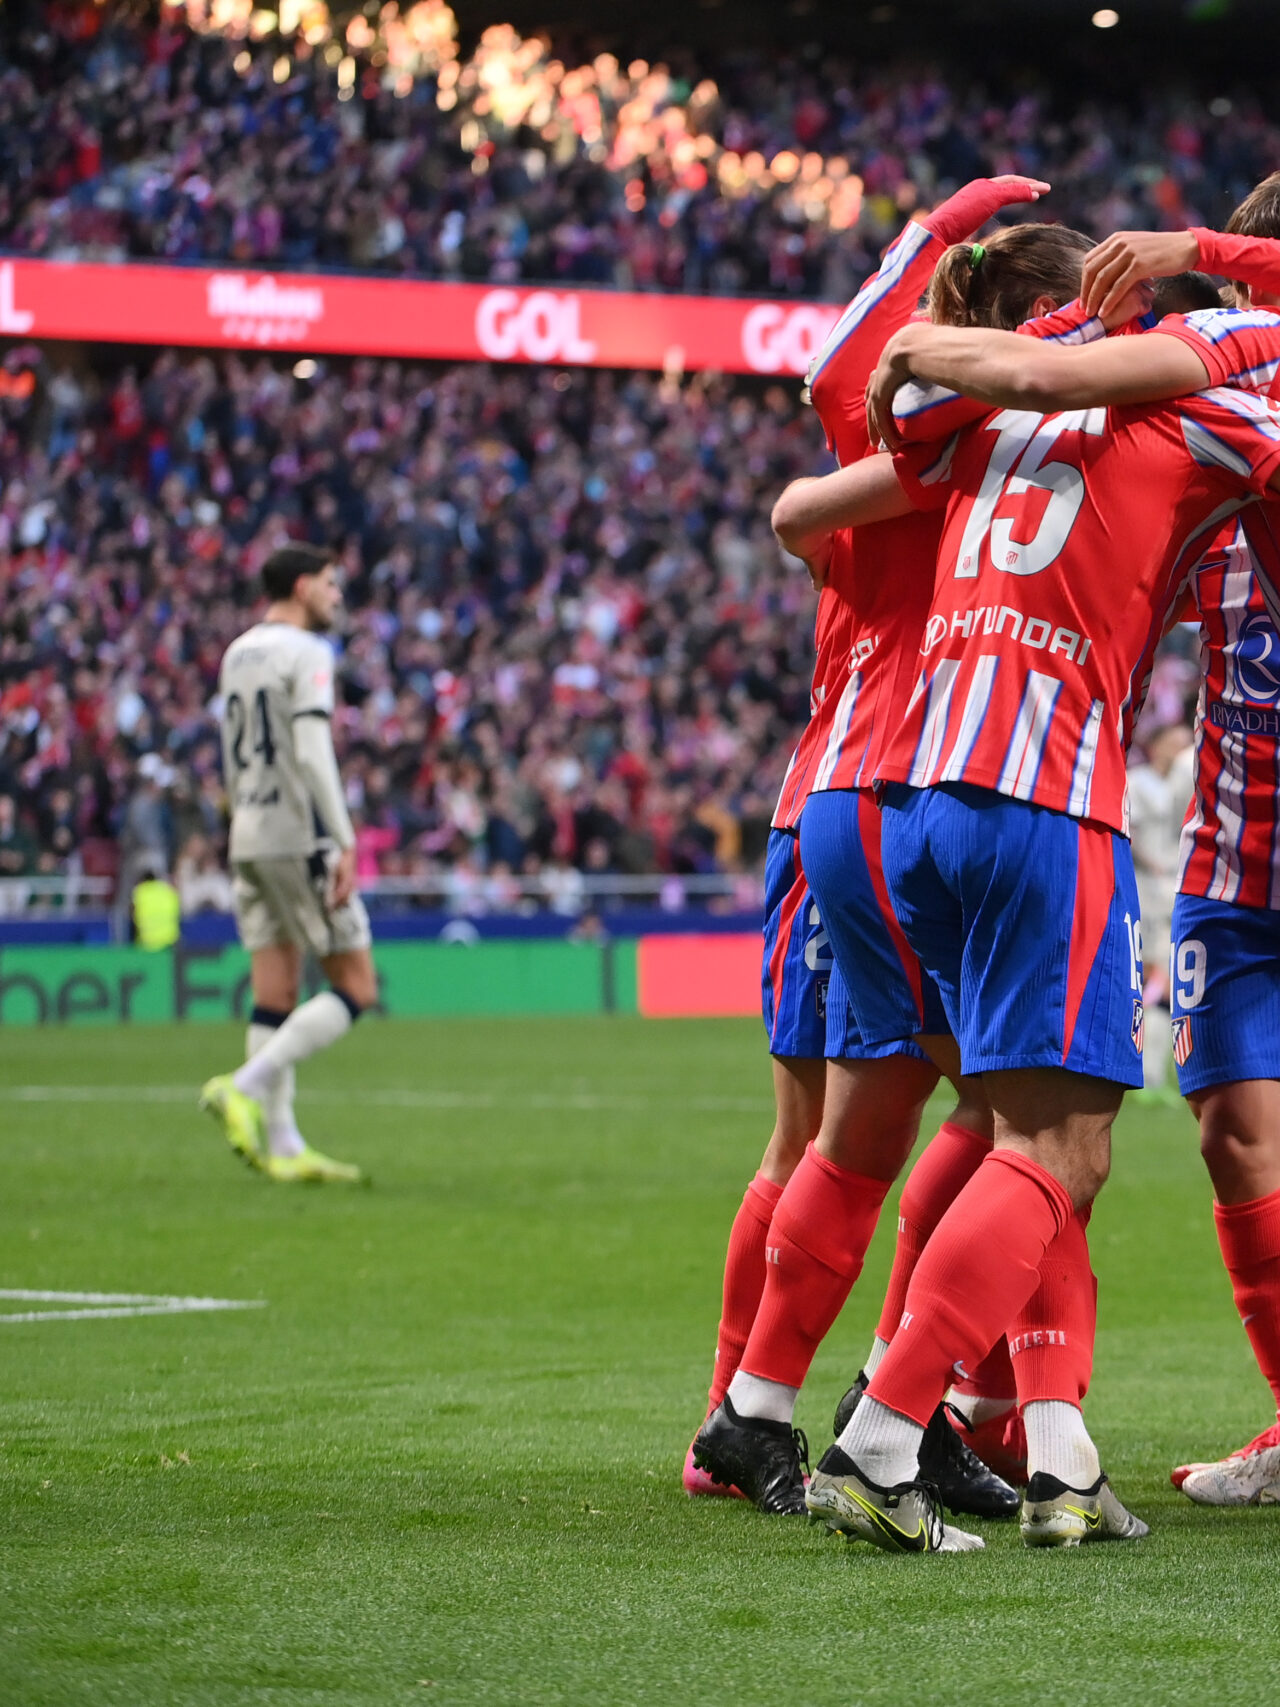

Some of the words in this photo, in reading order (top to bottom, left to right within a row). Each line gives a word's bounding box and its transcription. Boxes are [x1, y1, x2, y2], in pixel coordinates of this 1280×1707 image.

[475, 288, 598, 363] GOL
[741, 304, 842, 374] GO
[953, 407, 1107, 579] 15
[950, 605, 1092, 666] HYUNDAI
[1212, 703, 1280, 734] RIYADH
[1009, 1330, 1067, 1360] ATLETI
